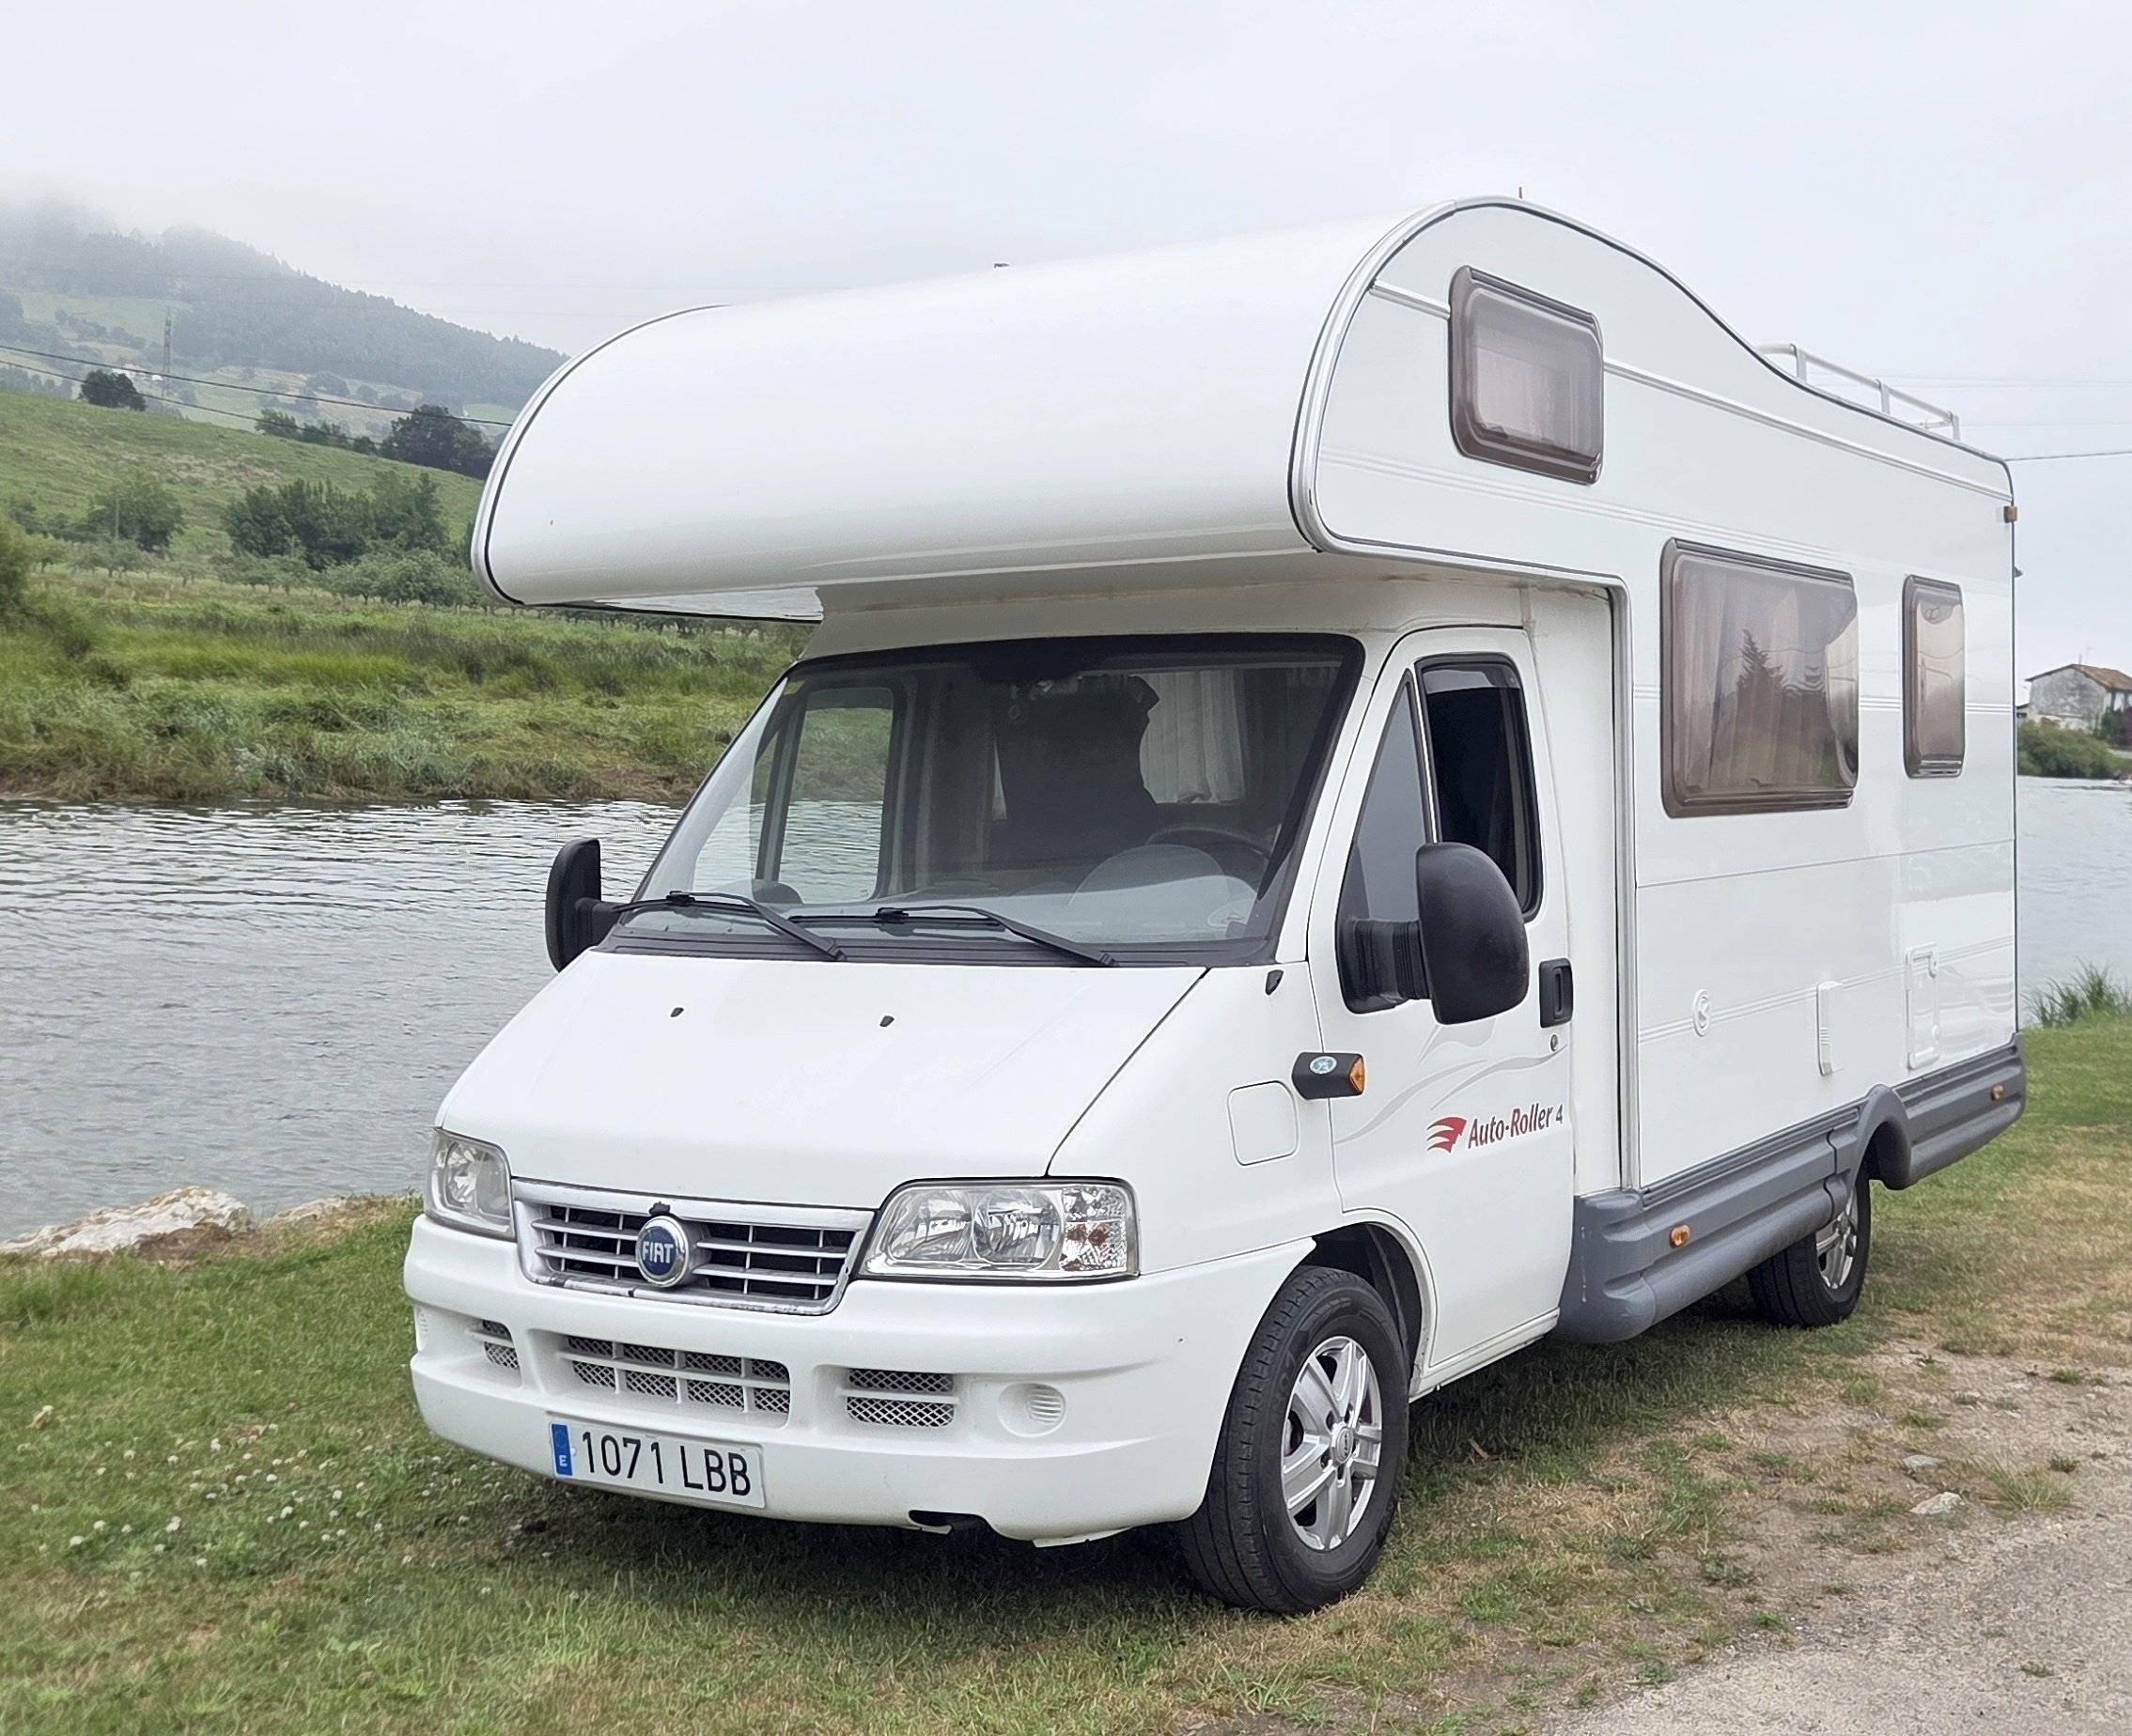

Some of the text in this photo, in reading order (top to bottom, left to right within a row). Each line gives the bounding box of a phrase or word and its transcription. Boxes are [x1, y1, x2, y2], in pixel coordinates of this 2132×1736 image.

[1556, 1104, 1564, 1124] 4
[642, 1241, 675, 1263] FIAT
[559, 1454, 568, 1467] E
[583, 1432, 751, 1496] 1071 LBB
